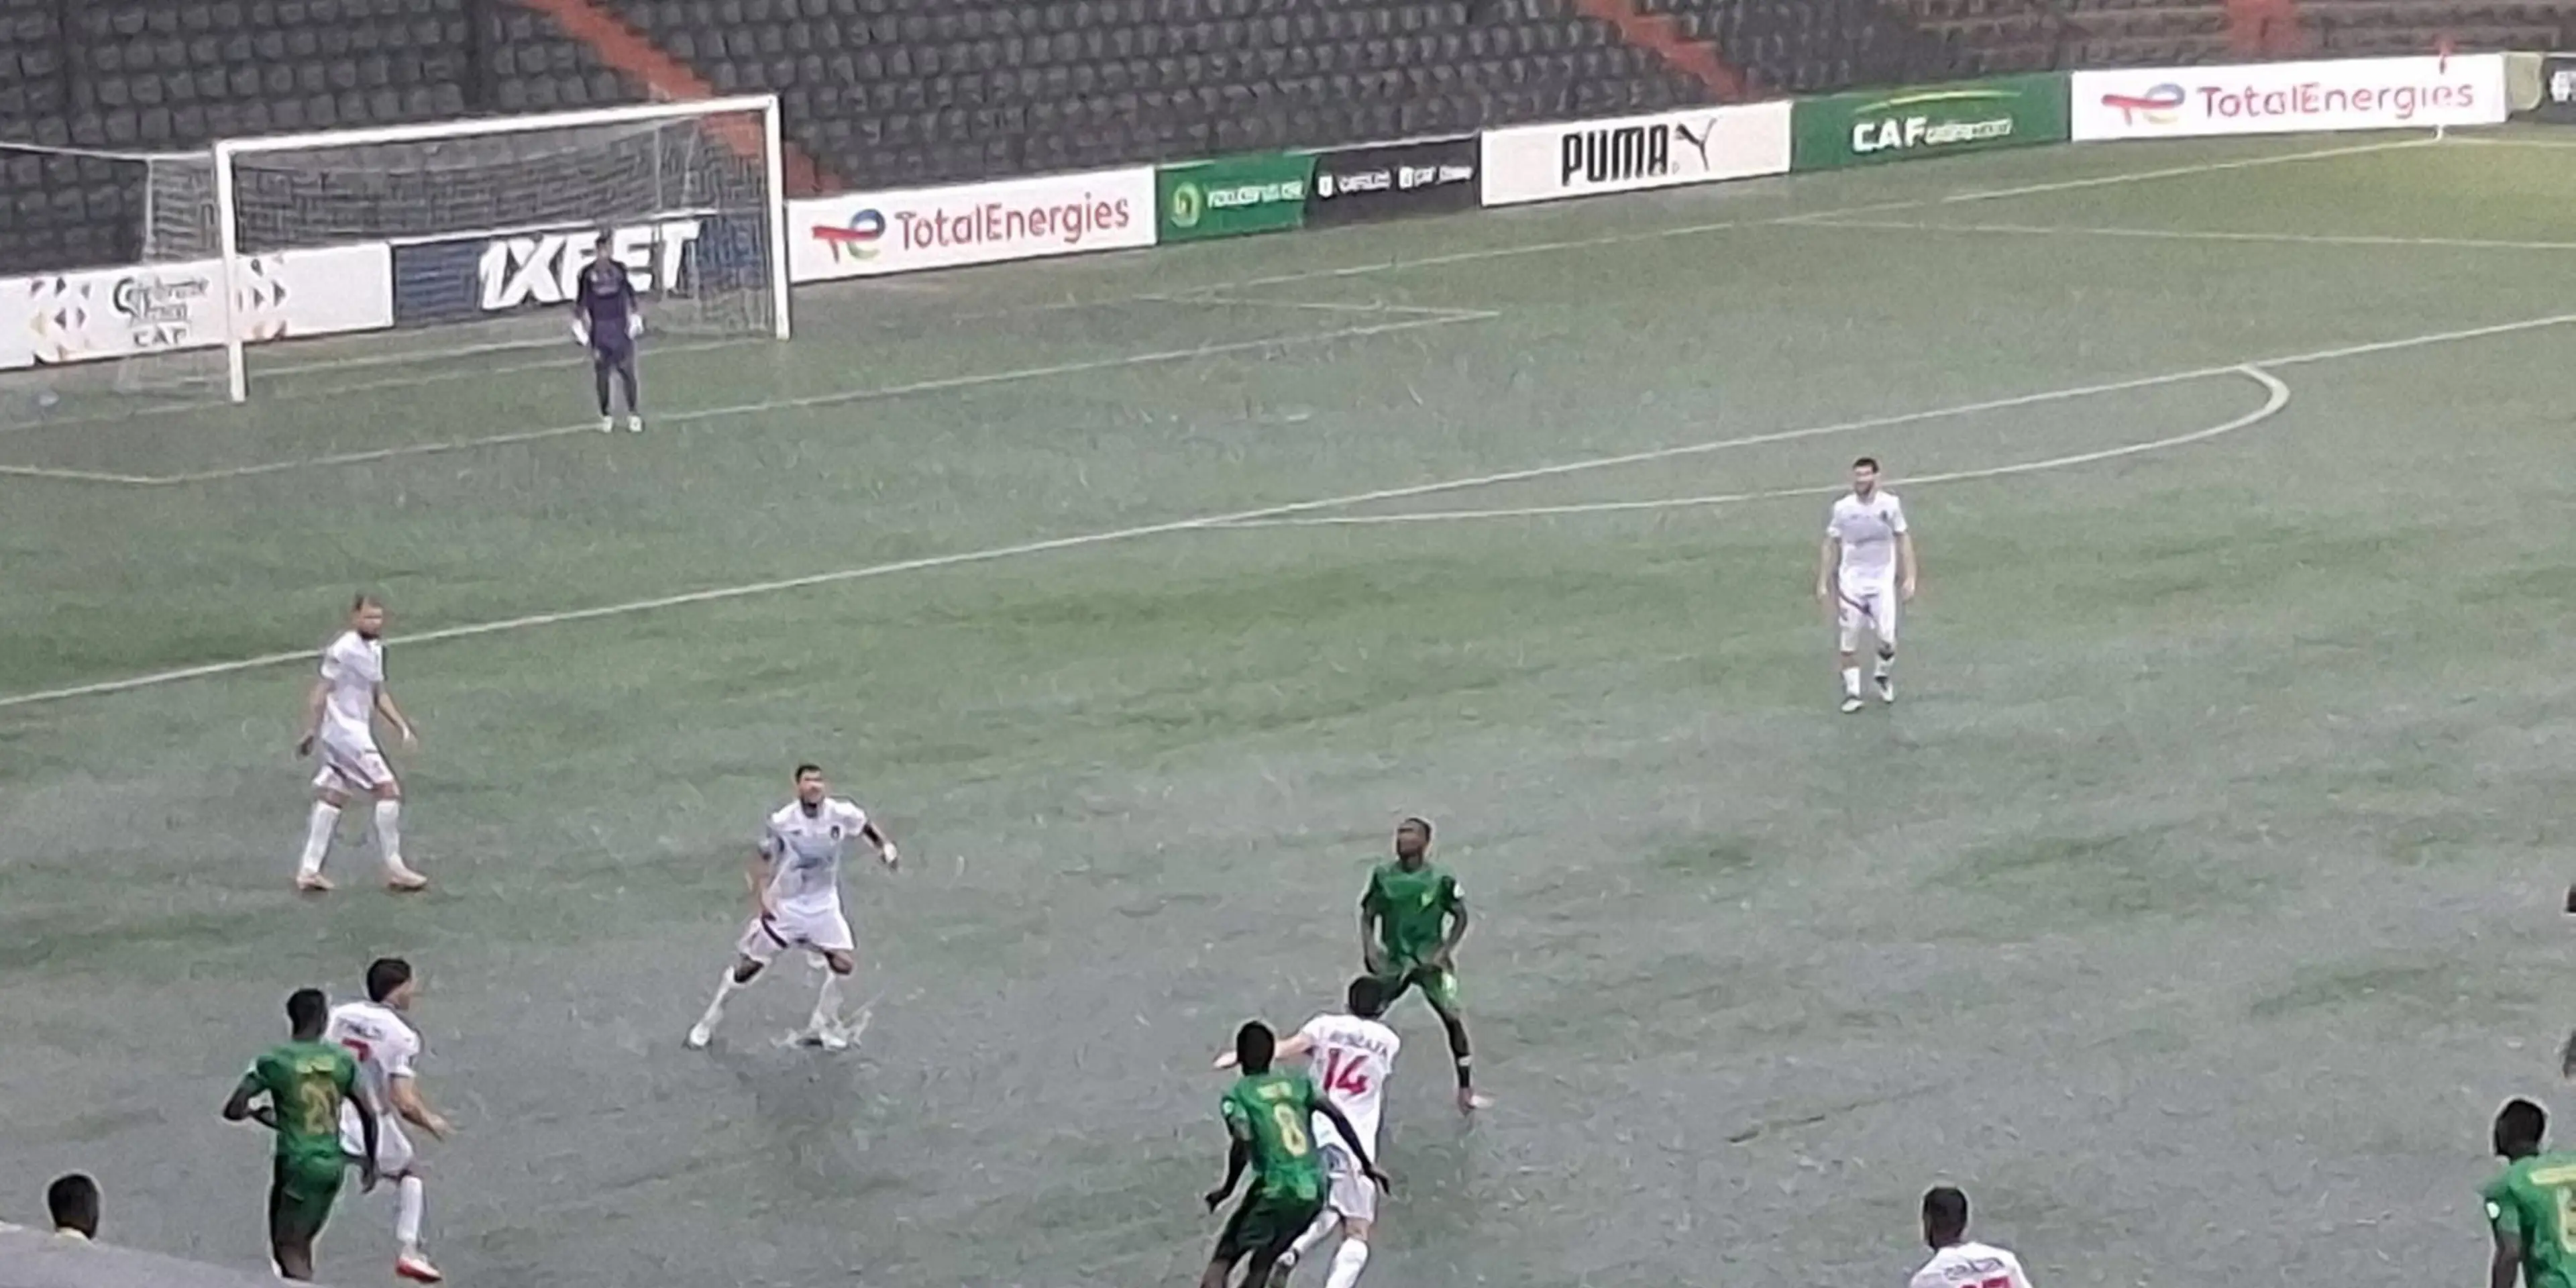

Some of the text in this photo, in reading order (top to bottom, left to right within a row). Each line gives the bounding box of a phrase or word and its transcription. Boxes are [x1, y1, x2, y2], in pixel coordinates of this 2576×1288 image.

[2196, 81, 2475, 119] TotalEnergies
[1561, 122, 1668, 186] PUMA
[1853, 116, 1927, 152] CAF
[894, 191, 1130, 250] TotalEnergies
[1323, 1047, 1369, 1095] 14
[1274, 1102, 1307, 1157] 8
